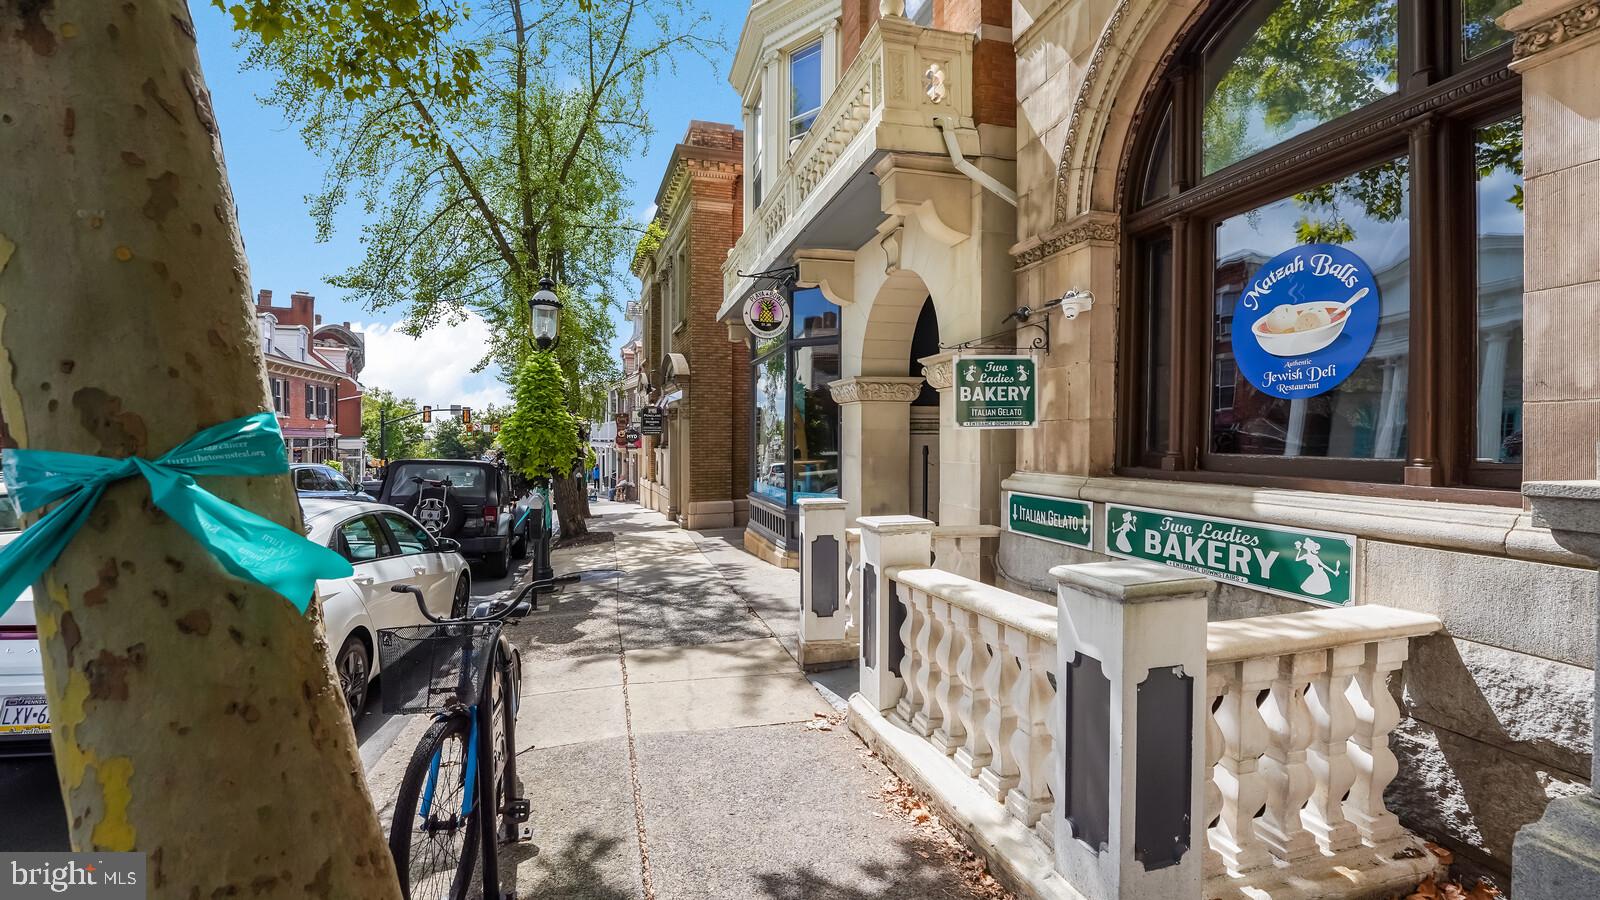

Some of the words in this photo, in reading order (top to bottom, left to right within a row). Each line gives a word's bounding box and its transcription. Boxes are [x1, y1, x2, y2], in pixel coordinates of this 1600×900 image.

[1243, 255, 1305, 311] Matzah
[1310, 253, 1360, 288] Balls
[984, 361, 1009, 372] Two
[1284, 358, 1313, 368] Authentic
[978, 373, 1014, 383] Ladies
[1262, 368, 1303, 387] Jewish
[1306, 364, 1337, 382] Deli
[959, 386, 1031, 402] BAKERY
[1276, 382, 1320, 394] Restaurant
[971, 408, 996, 417] ITALIAN
[997, 407, 1022, 416] GELATO
[1019, 505, 1046, 524] ITALIAN
[1047, 510, 1079, 531] GELATO
[1159, 516, 1194, 535] Two
[1198, 522, 1260, 547] Ladies
[1144, 528, 1280, 580] BAKERY
